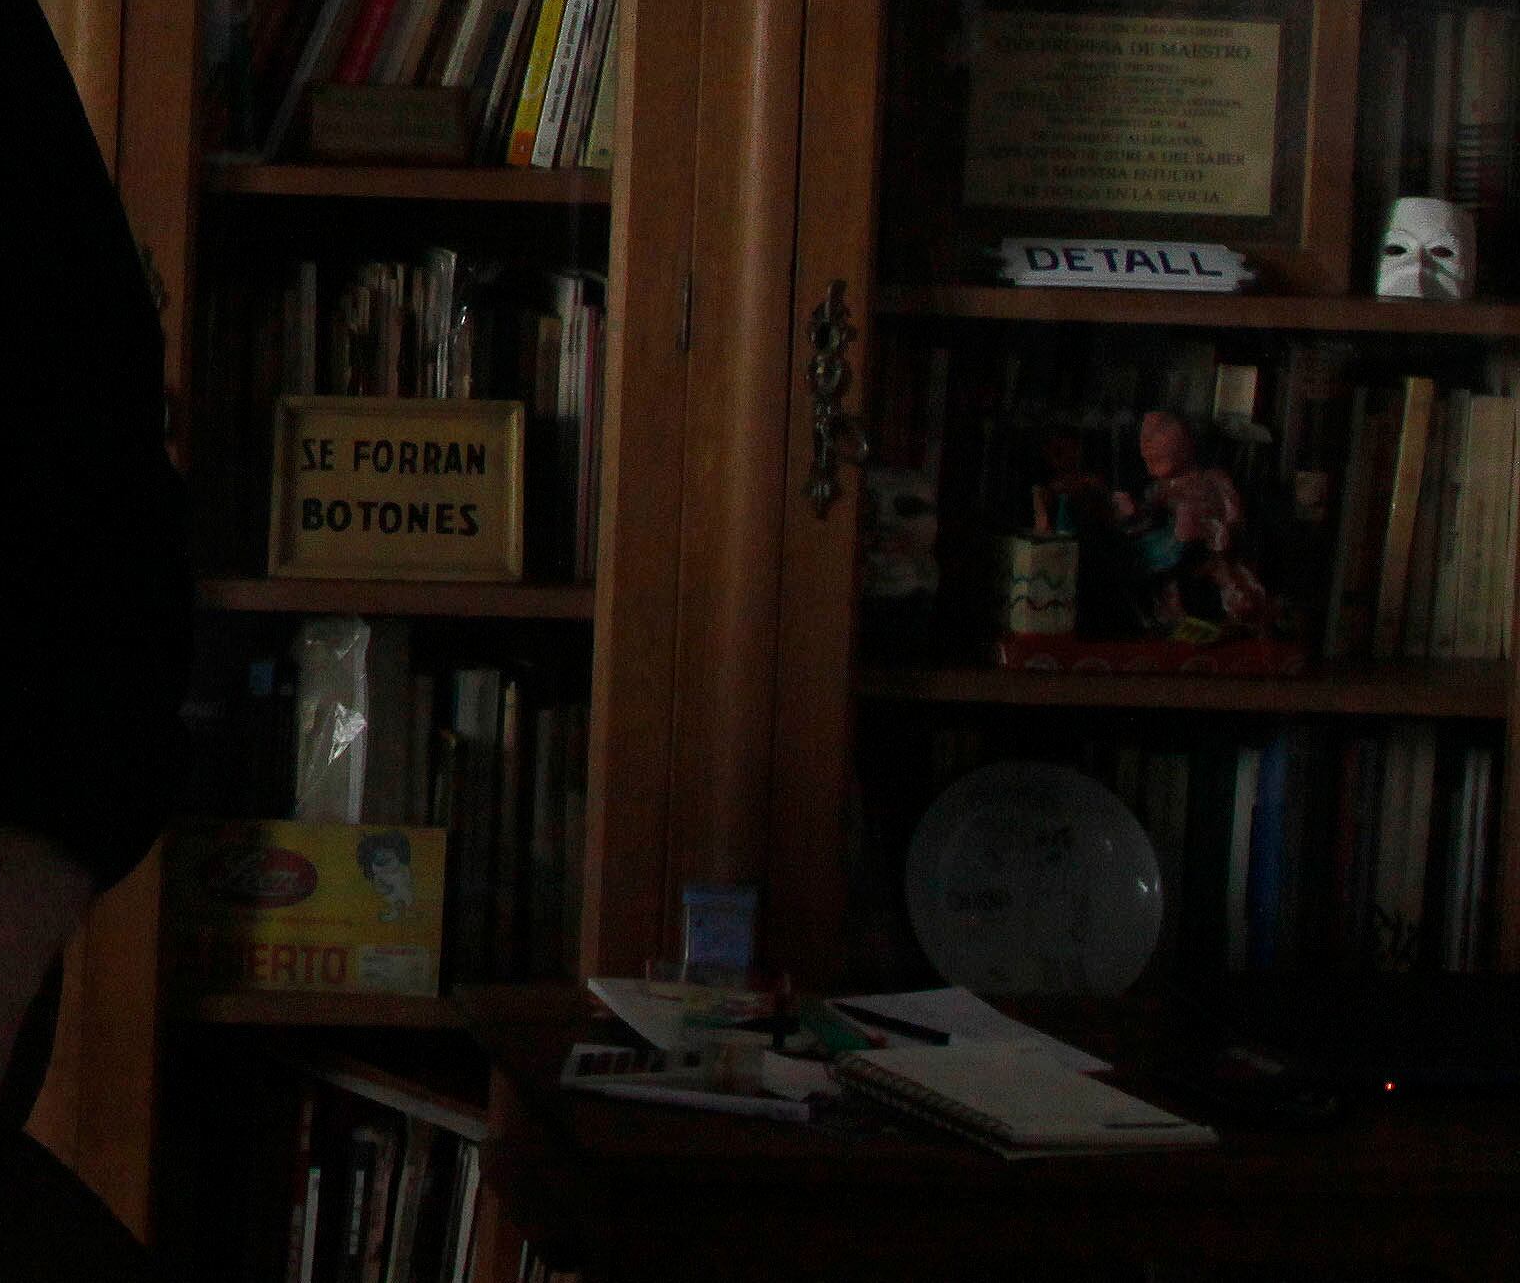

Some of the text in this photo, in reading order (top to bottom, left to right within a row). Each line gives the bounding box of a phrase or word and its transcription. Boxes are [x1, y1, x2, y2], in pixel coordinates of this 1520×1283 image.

[1162, 42, 1251, 60] MAESTRO
[1024, 246, 1223, 278] DETALL
[301, 438, 486, 475] SE FORRAN
[302, 499, 479, 536] BOTONES
